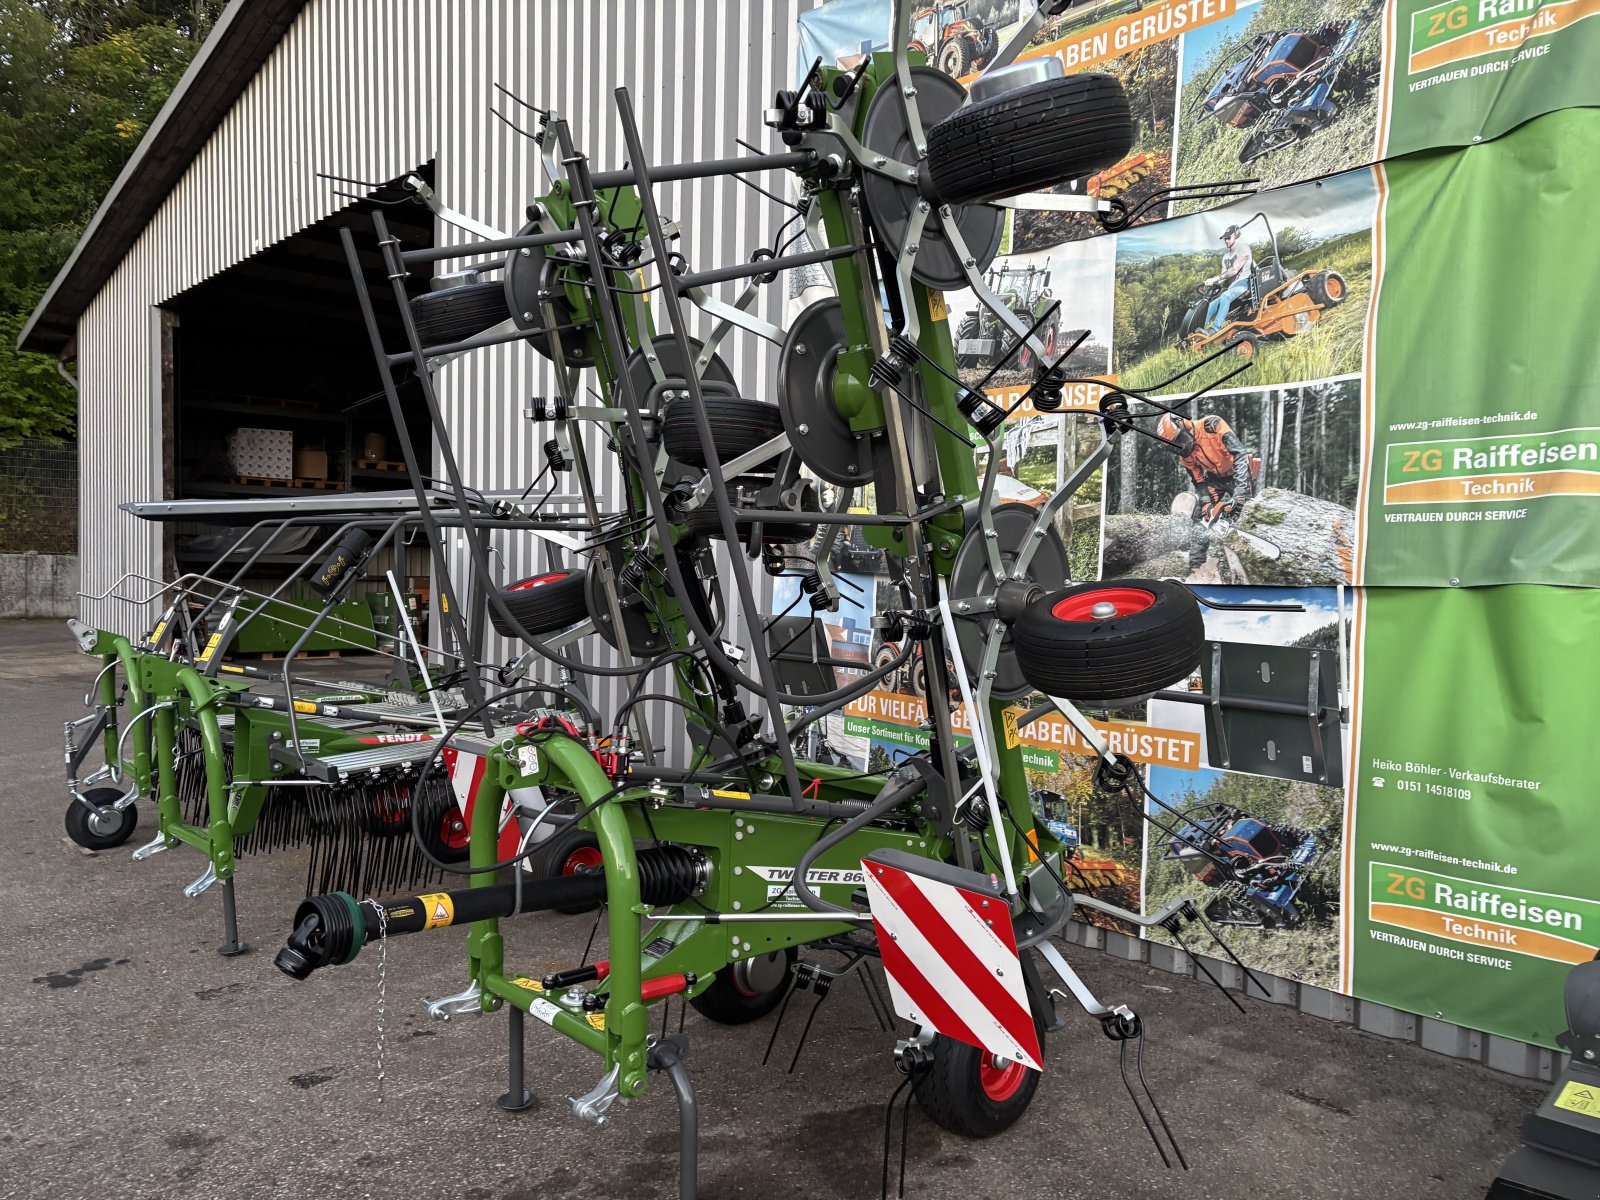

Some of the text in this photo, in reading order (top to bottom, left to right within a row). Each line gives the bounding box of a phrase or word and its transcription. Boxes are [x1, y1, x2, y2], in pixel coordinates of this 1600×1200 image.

[1427, 6, 1468, 37] ZG
[1408, 67, 1468, 93] VERTRAUEN
[1470, 60, 1509, 77] DURCH
[1389, 411, 1538, 431] www.zg-raiffeisen-technik.de
[1402, 442, 1597, 473] ZG Raiffeisen
[1459, 477, 1535, 496] Technik
[1384, 508, 1528, 523] VERTRAUEN DURCH SERVICE
[376, 733, 424, 744] FENDT
[847, 721, 870, 734] Unser
[872, 725, 903, 741] Sortiment
[904, 732, 914, 742] für
[1020, 750, 1054, 768] echnik
[1372, 758, 1541, 790] Heiko Böhler Verkaufsberater
[1397, 779, 1472, 800] 0151 14518109
[1370, 842, 1518, 875] www.zg-raiffeisen-technik.de
[768, 869, 840, 882] TWTER
[1386, 872, 1582, 931] ZG Raiffeisen
[1441, 916, 1518, 946] Technik
[1370, 929, 1512, 970] VERTRAUEN DURCH SERVICE
